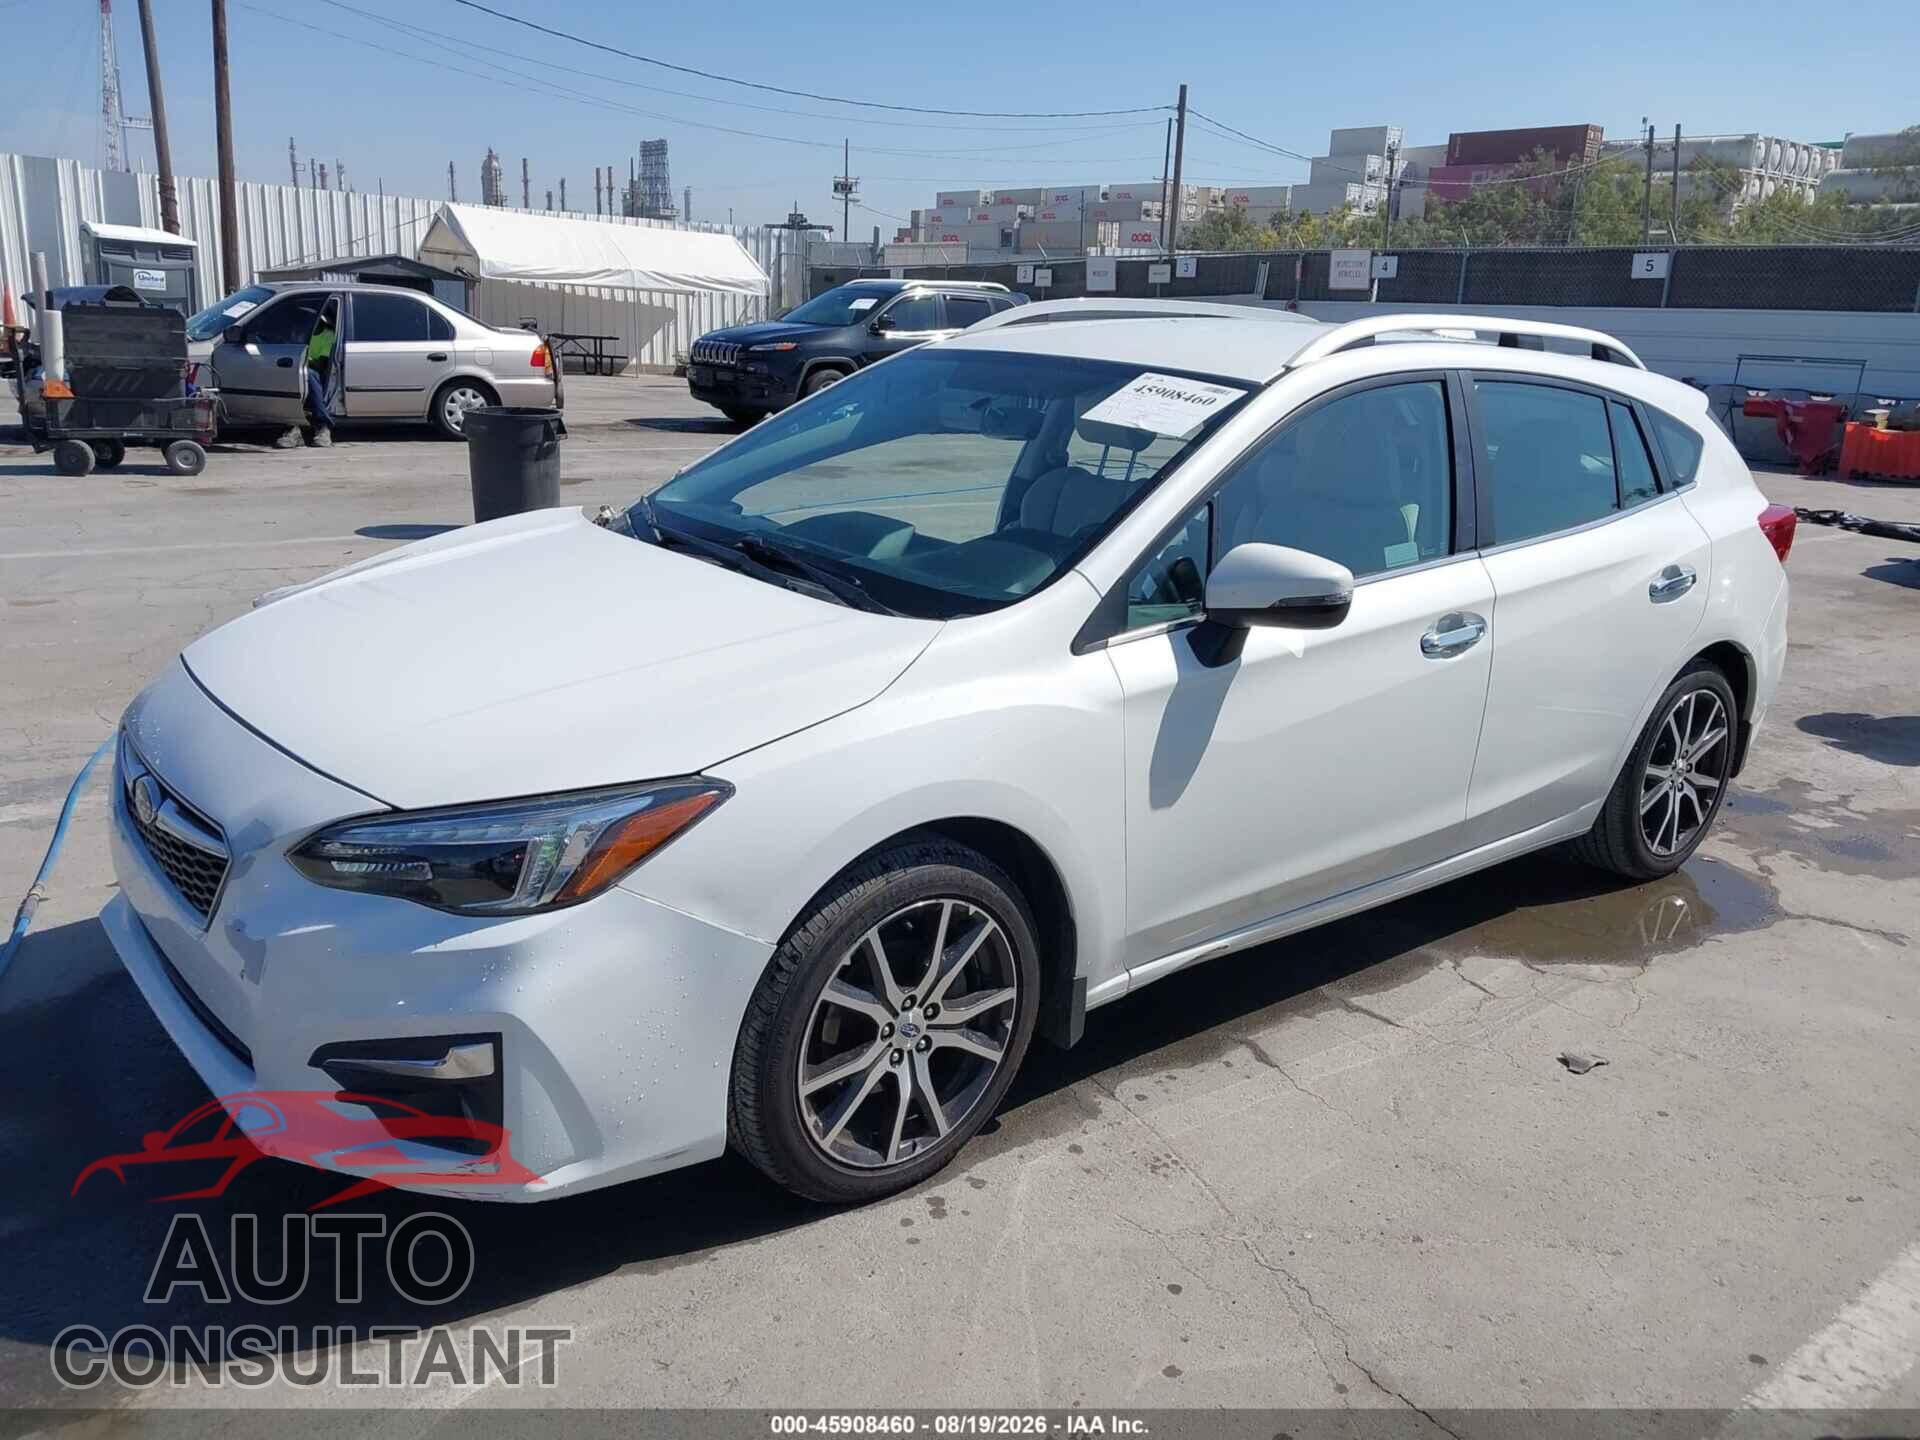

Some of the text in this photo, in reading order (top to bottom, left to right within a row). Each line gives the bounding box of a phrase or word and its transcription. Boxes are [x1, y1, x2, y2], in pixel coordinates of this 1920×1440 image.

[1183, 262, 1190, 273] 3
[1381, 261, 1389, 272] 4
[1645, 259, 1655, 272] 5
[1133, 383, 1218, 407] 45908460
